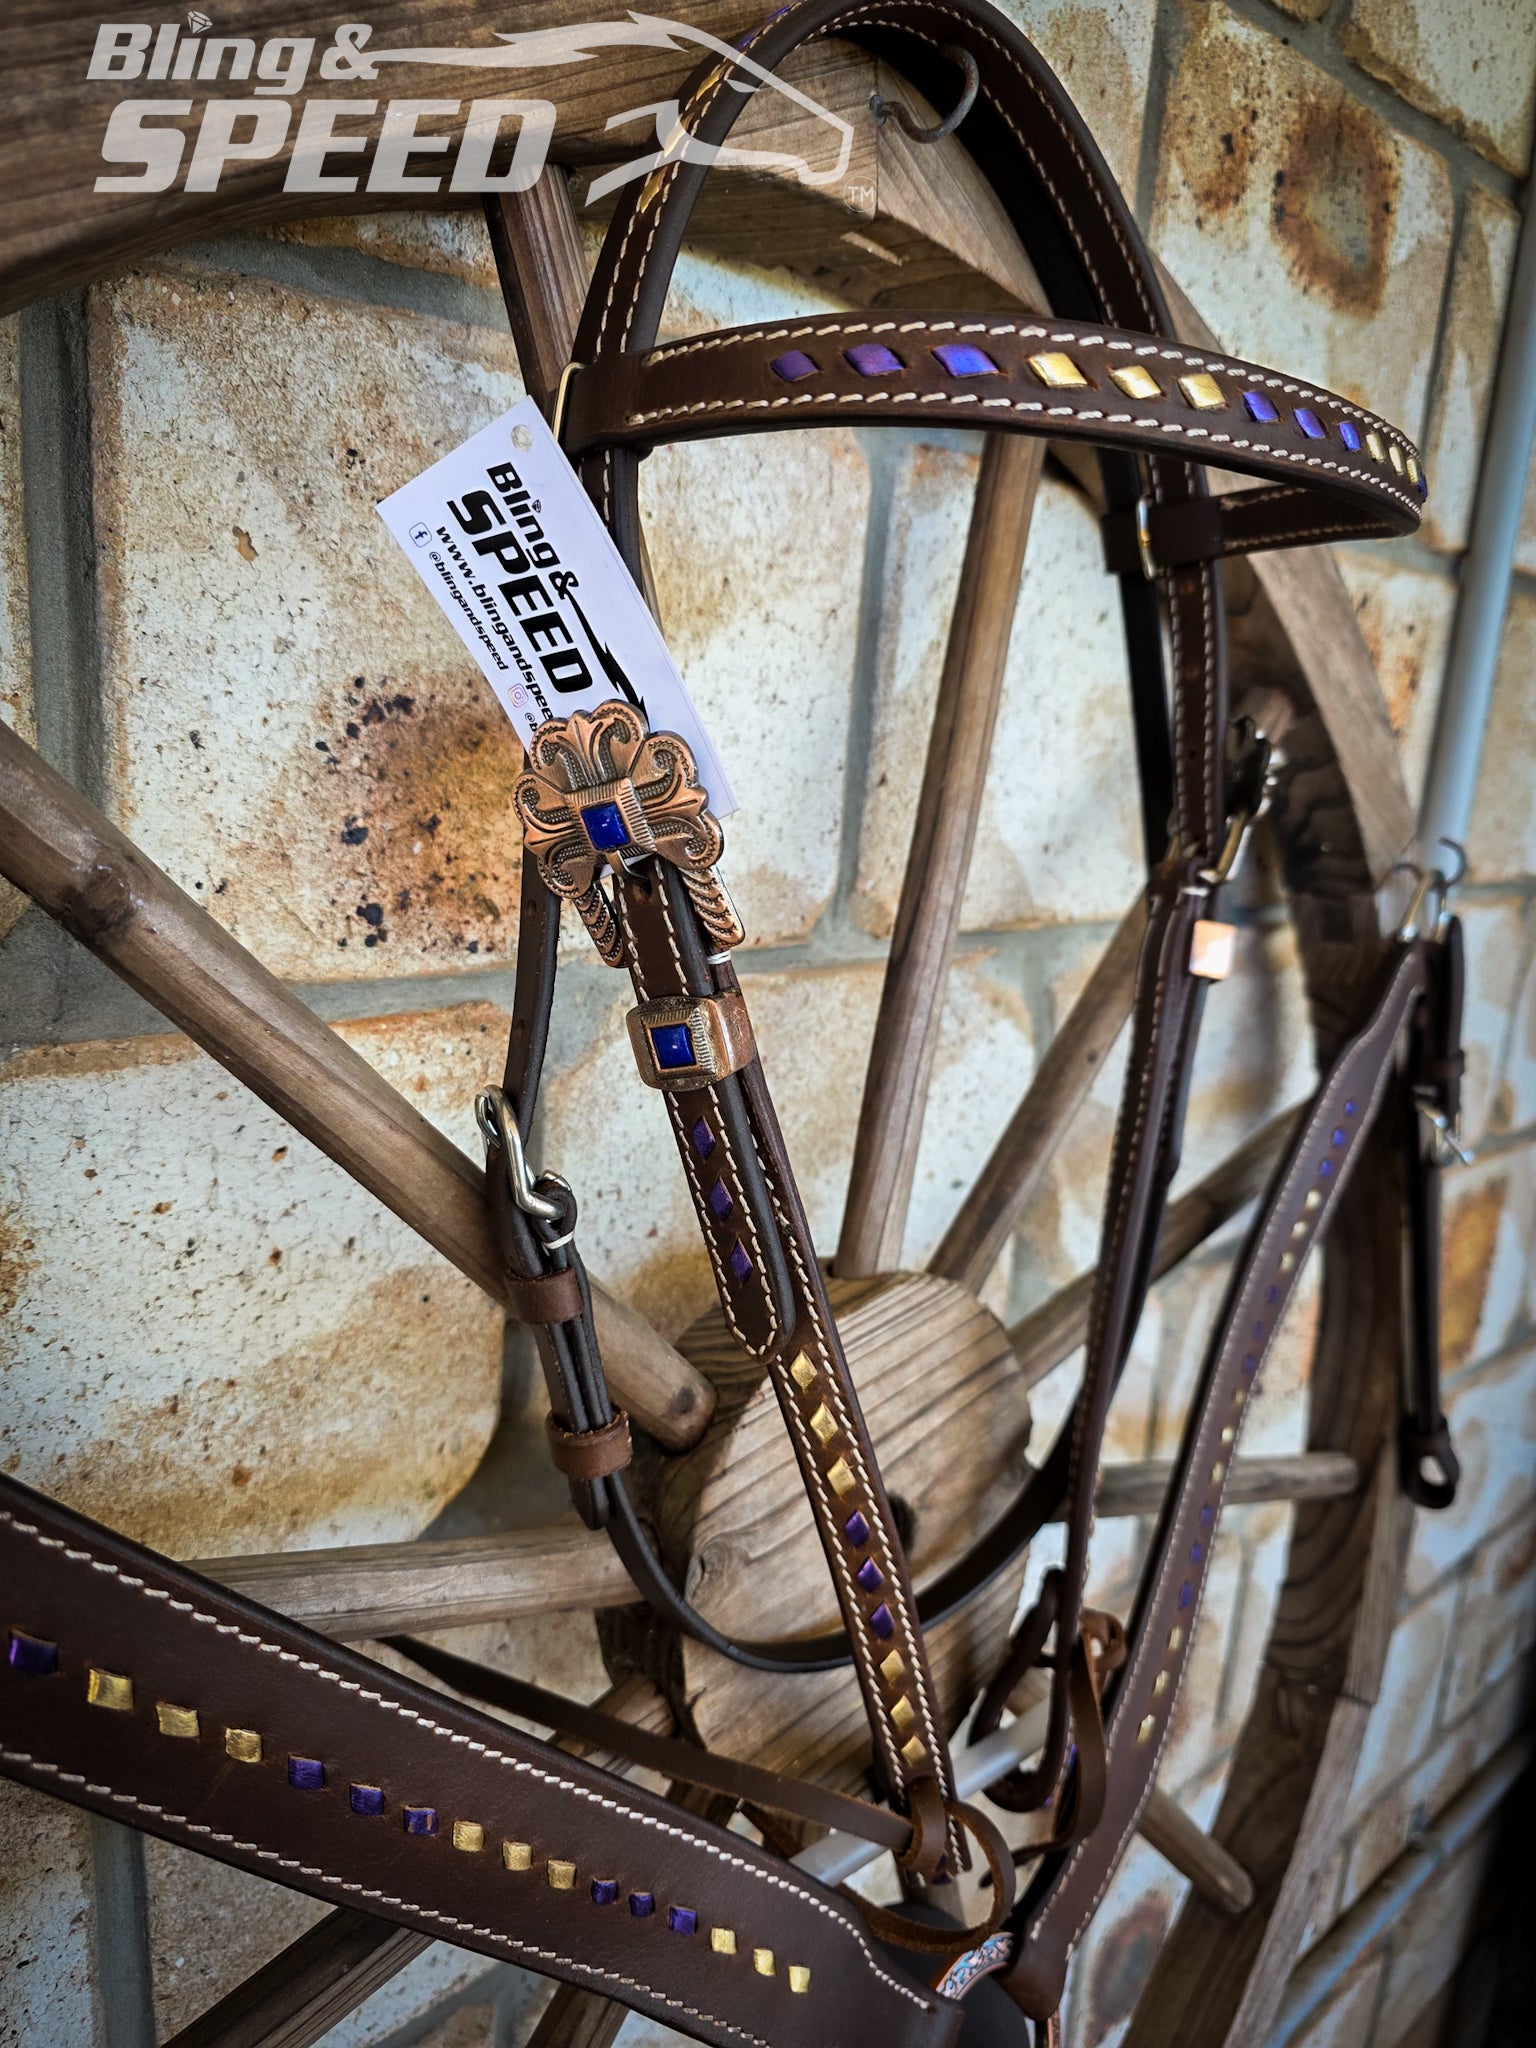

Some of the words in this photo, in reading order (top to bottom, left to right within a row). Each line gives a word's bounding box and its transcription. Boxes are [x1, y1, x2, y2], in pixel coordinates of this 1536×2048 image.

[428, 551, 510, 671] @blingandspeed
[435, 526, 554, 721] www.blingandspee
[446, 489, 594, 694] SPEED
